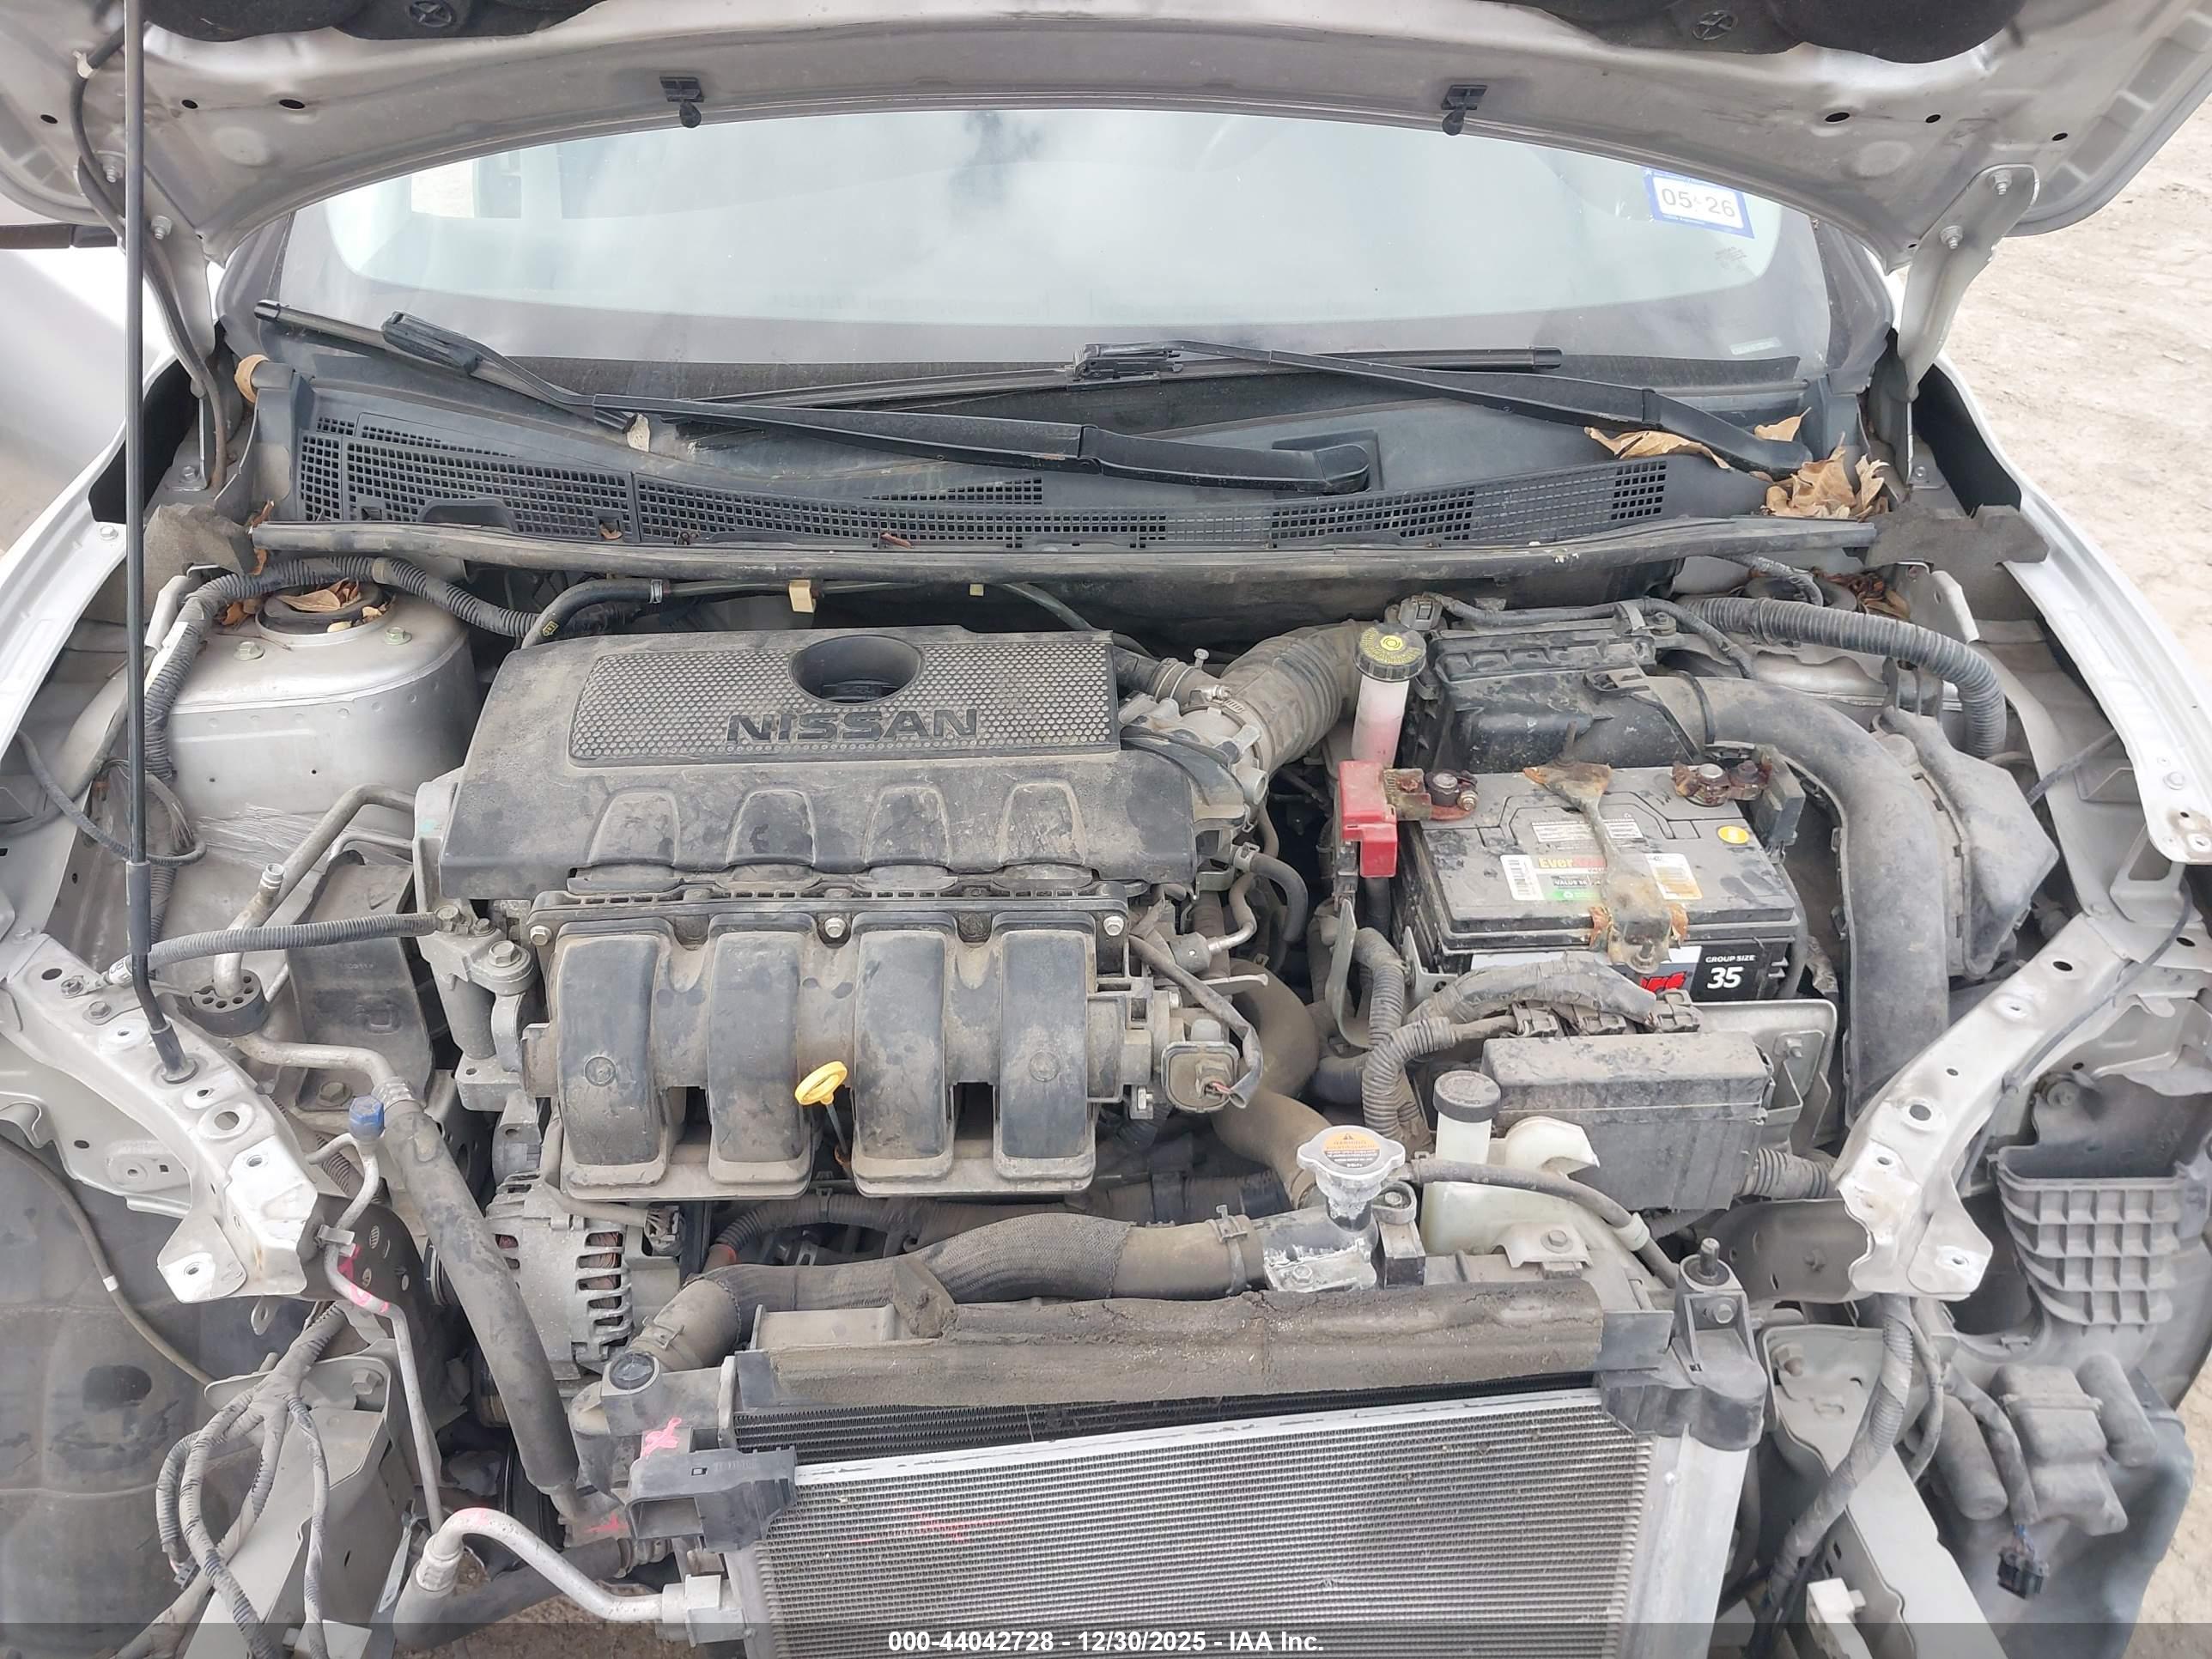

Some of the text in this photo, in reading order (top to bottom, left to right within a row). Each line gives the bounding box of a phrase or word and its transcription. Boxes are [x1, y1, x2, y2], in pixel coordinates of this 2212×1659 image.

[1662, 188, 1735, 217] 05 26
[726, 708, 978, 744] NISSAN
[1705, 955, 1736, 963] GROUP
[1706, 966, 1744, 989] 35
